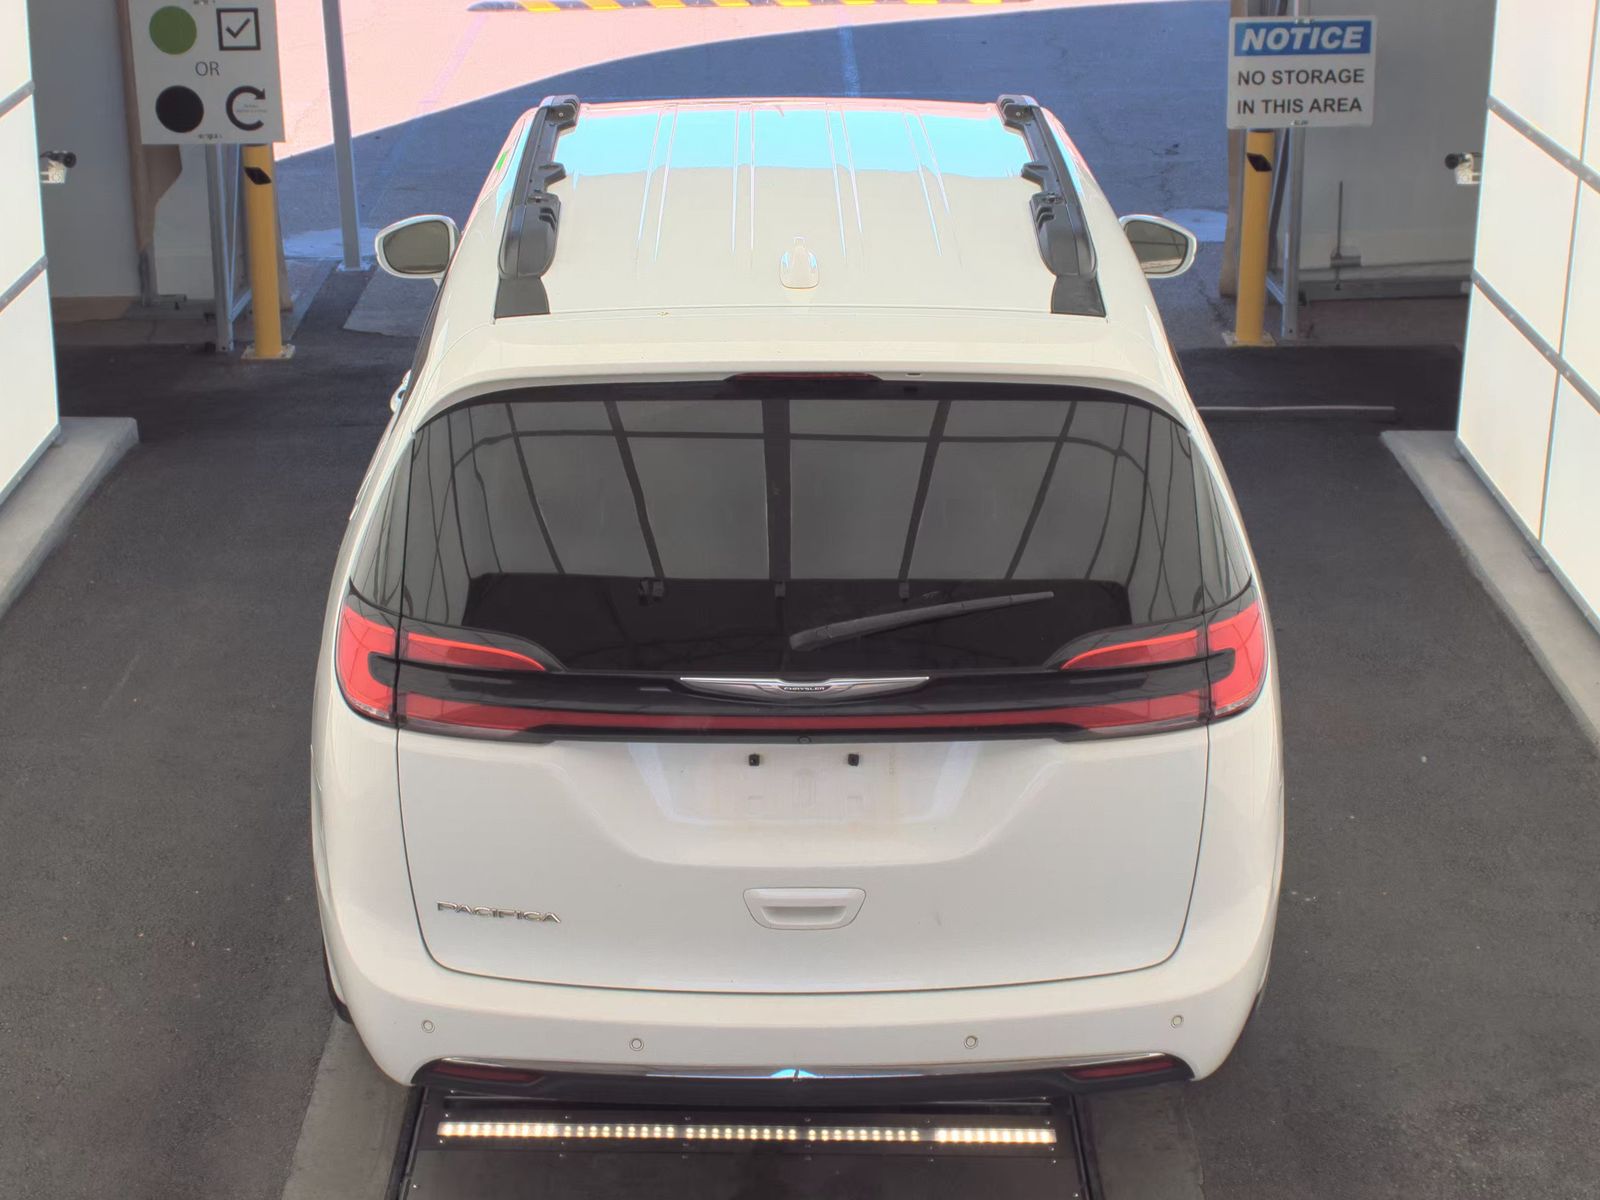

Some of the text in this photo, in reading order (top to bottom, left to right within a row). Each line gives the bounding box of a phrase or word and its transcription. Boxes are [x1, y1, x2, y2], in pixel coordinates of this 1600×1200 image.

[1241, 26, 1365, 51] NOTICE
[194, 61, 220, 77] OR
[1237, 68, 1365, 86] NO STORAGE
[1237, 97, 1363, 115] IN THIS AREA
[437, 901, 561, 923] PACIFICA
